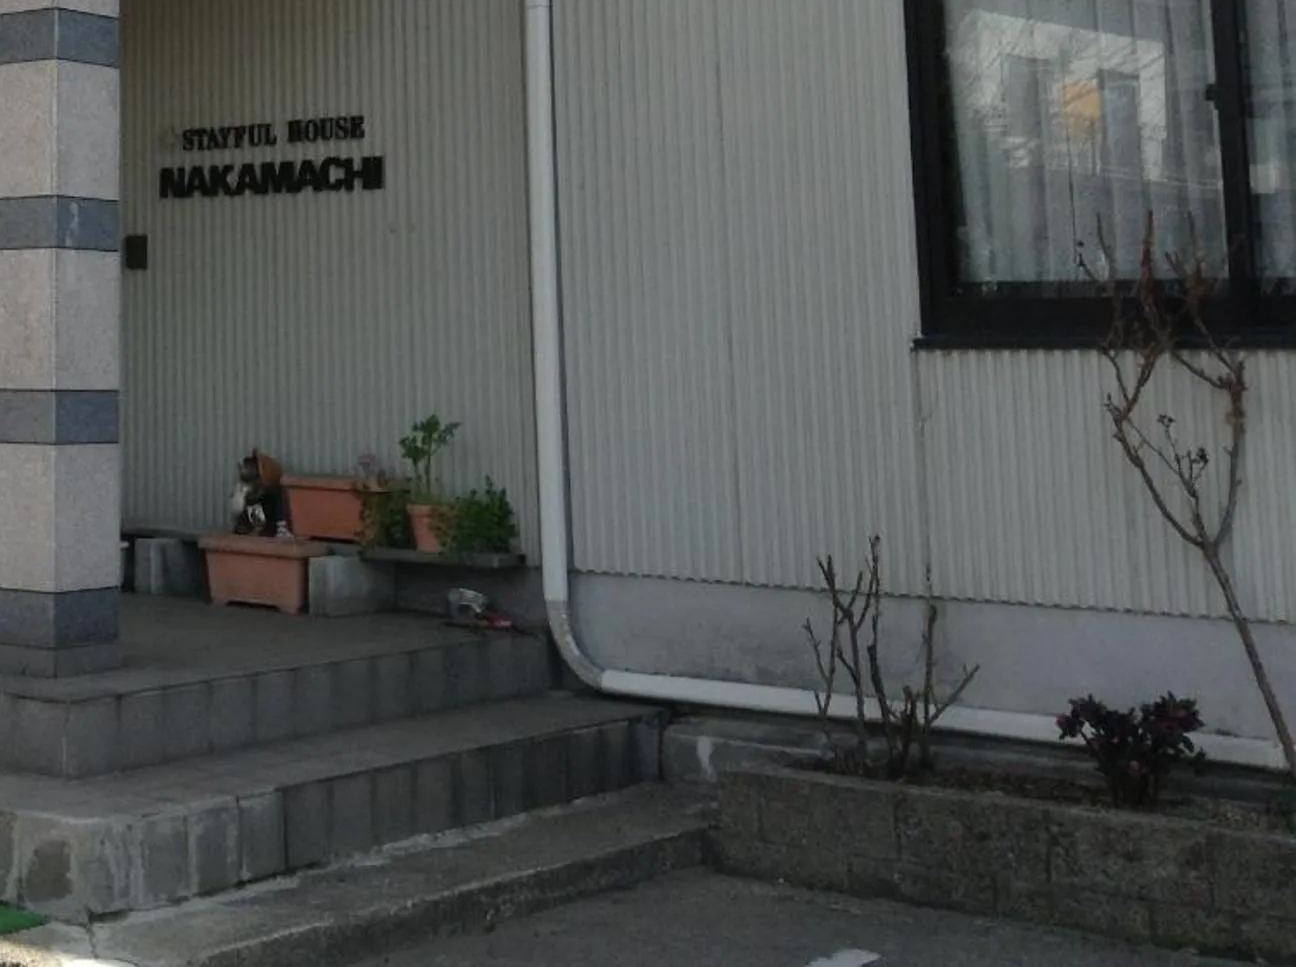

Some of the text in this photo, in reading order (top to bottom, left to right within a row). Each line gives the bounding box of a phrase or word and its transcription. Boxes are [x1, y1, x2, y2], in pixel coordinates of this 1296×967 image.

[182, 115, 366, 151] STAYFUL HOUSE
[159, 155, 384, 199] NAKAMACHI
